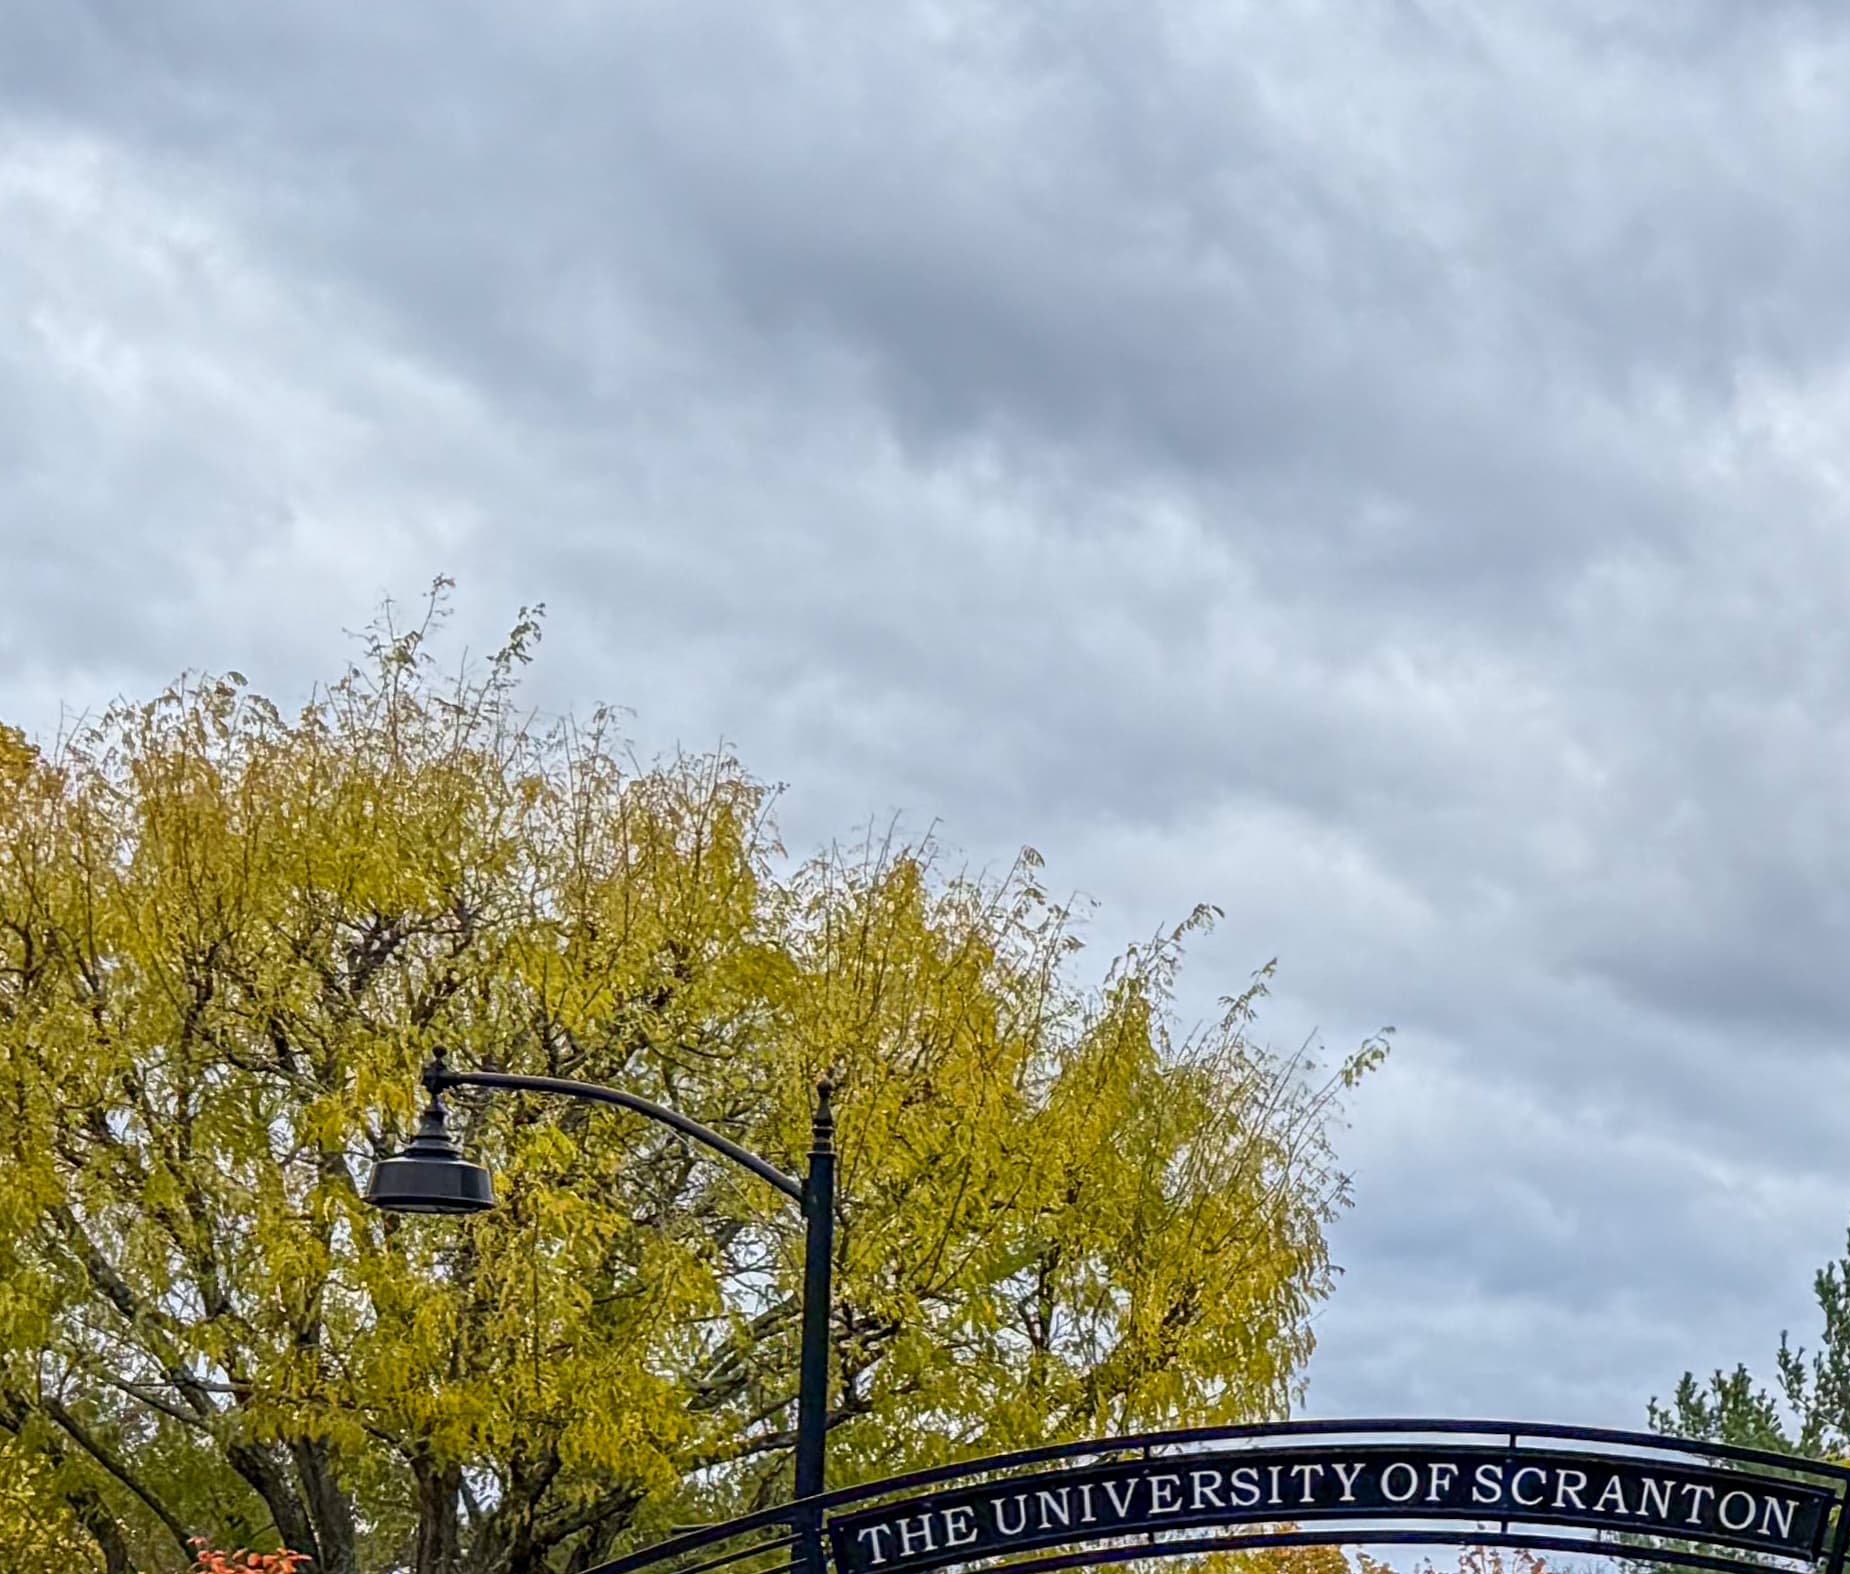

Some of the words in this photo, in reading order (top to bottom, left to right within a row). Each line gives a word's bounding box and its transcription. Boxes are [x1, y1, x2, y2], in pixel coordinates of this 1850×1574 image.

[857, 1505, 979, 1565] THE
[990, 1463, 1366, 1536] UNIVERSITY
[1380, 1462, 1459, 1502] OF
[1471, 1464, 1800, 1539] SCRANTON
